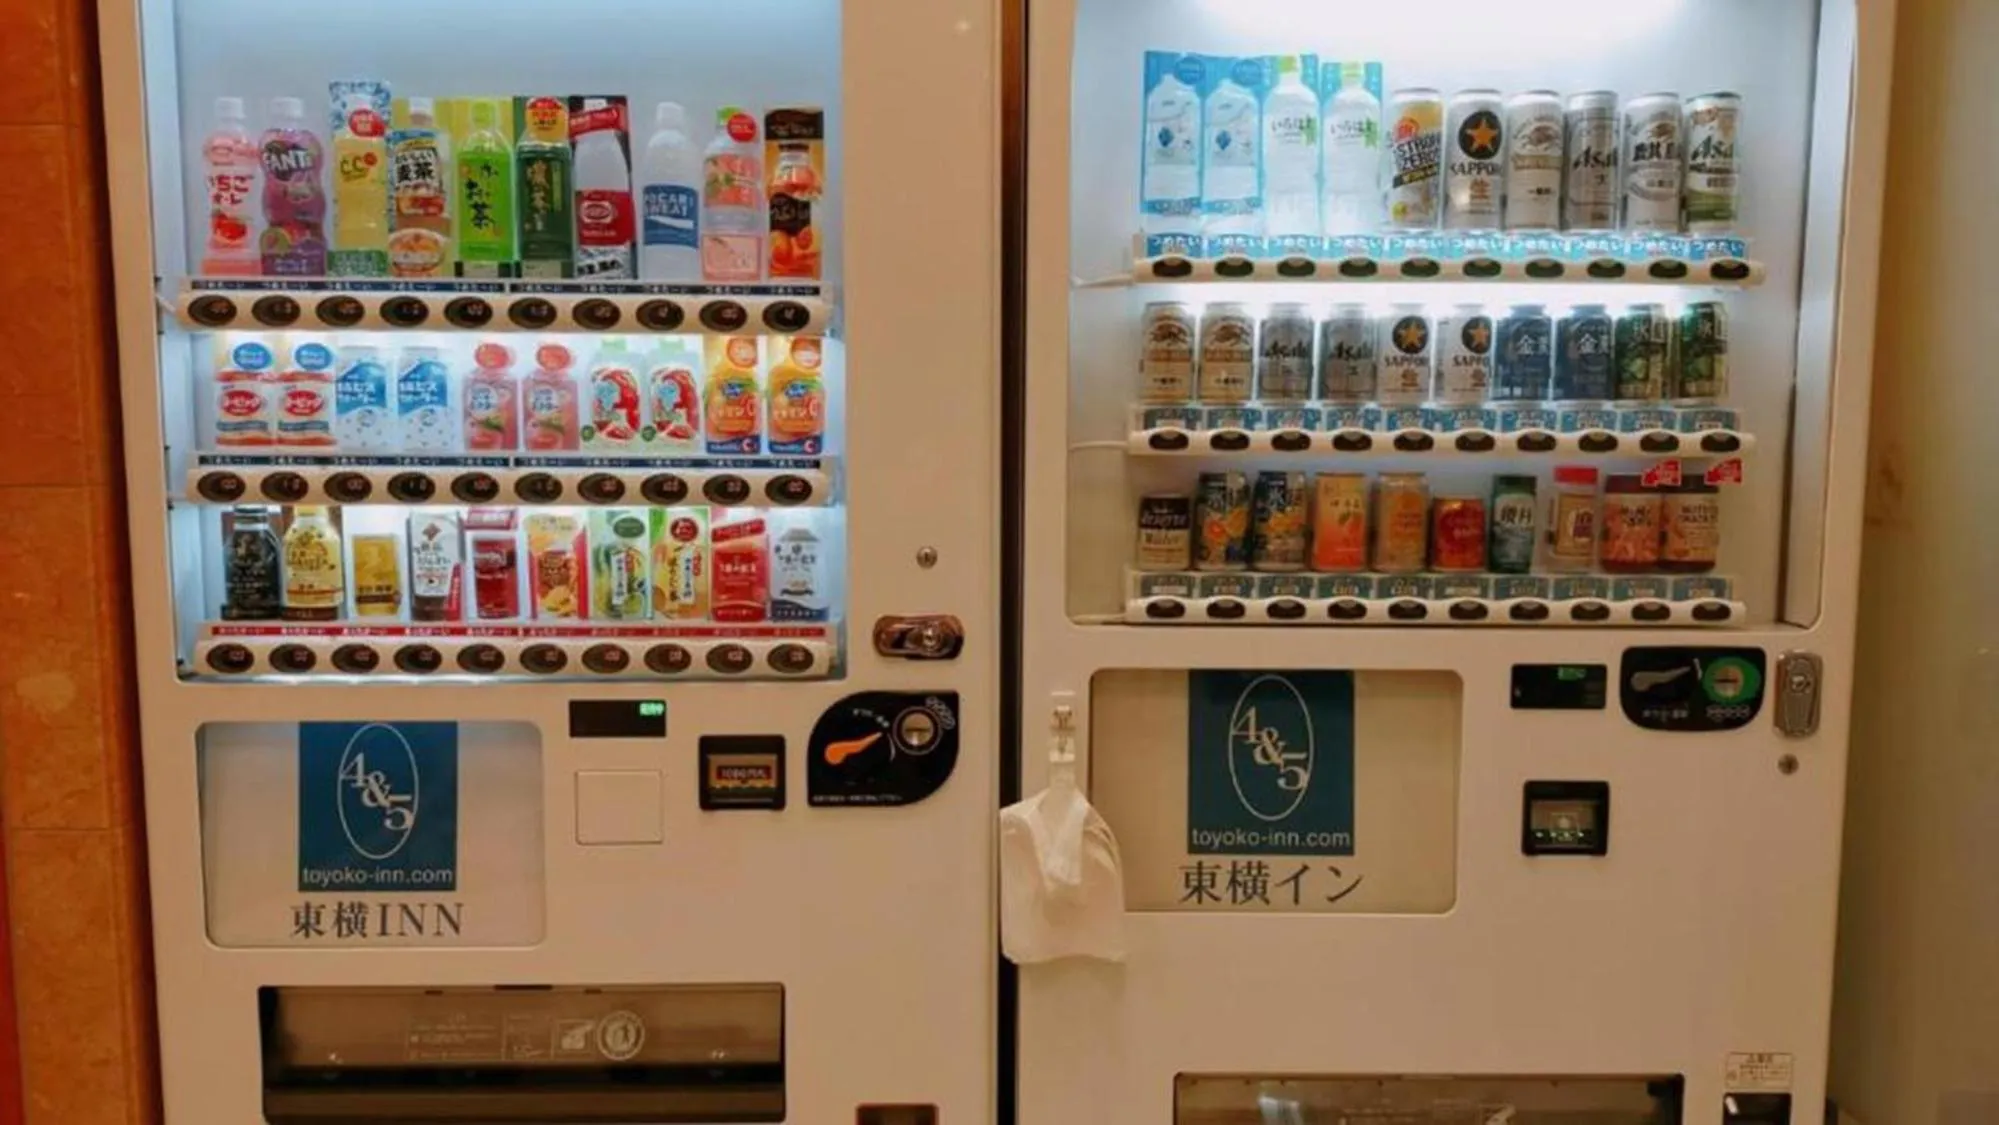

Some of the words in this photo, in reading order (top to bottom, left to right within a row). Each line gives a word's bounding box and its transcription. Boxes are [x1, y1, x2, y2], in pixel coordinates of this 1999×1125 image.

[1192, 827, 1350, 850] toyoko-inn.com
[302, 865, 454, 888] toyoko-inn.com
[1178, 860, 1364, 906] 東横イン
[290, 901, 465, 939] 東横INN
